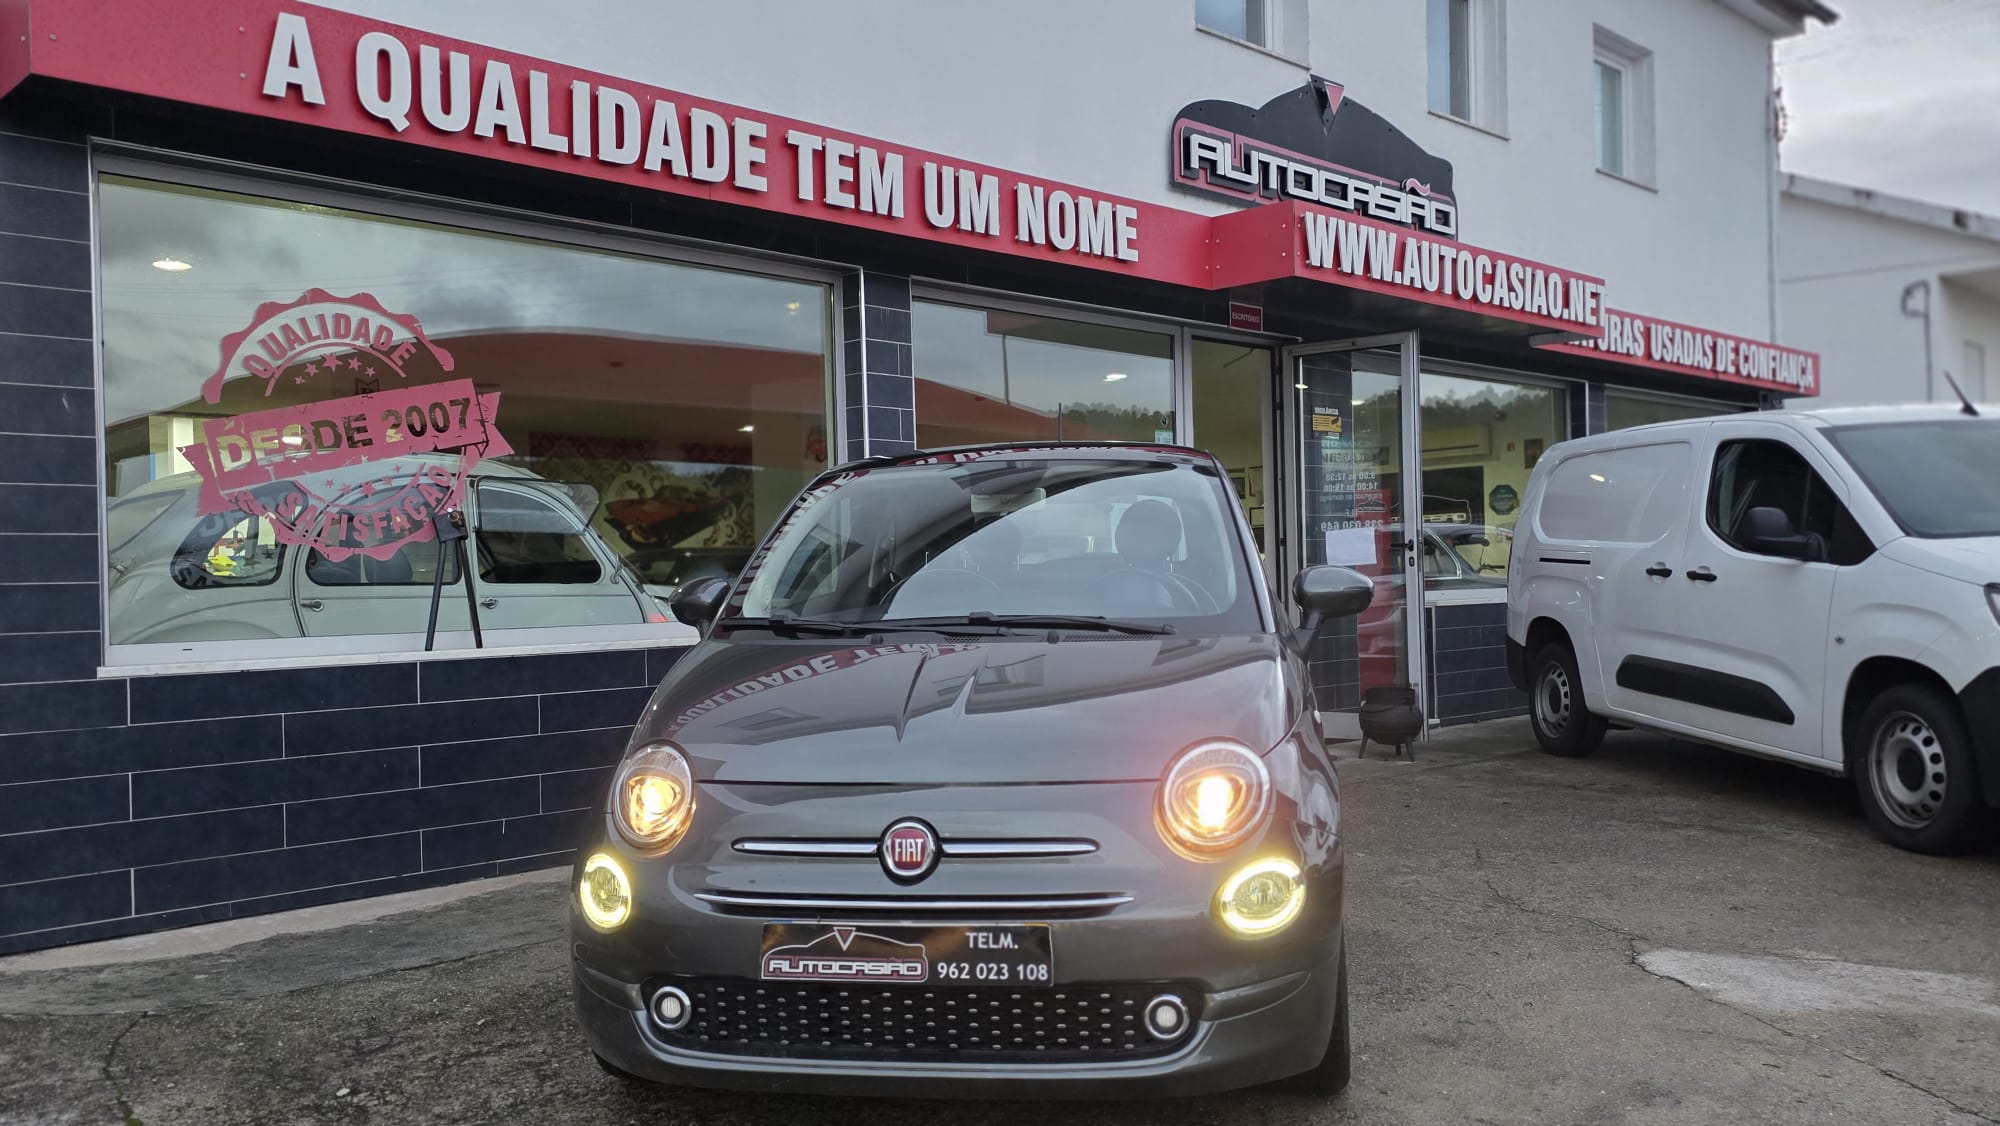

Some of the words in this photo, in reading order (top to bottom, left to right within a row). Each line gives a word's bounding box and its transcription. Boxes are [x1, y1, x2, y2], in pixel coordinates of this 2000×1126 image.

[262, 12, 326, 105] A
[355, 31, 768, 193] QUALIDADE
[786, 130, 905, 218] TEM
[922, 161, 1001, 237] UM
[1016, 182, 1140, 262] NOME
[1304, 210, 1607, 328] WWW.AUTOCASIAO.NET
[241, 312, 416, 378] QUALIDADE
[1567, 314, 1646, 358] URAS
[1650, 323, 1713, 371] USADAS
[1716, 337, 1736, 375] DE
[1738, 342, 1815, 392] CONFIANÇA
[216, 413, 374, 473] DESDE
[382, 397, 471, 442] 2007
[894, 837, 924, 862] FIAT
[936, 962, 970, 980] 962
[975, 963, 1009, 980] 023
[1016, 963, 1049, 981] 108
[965, 931, 1019, 949] TELM.
